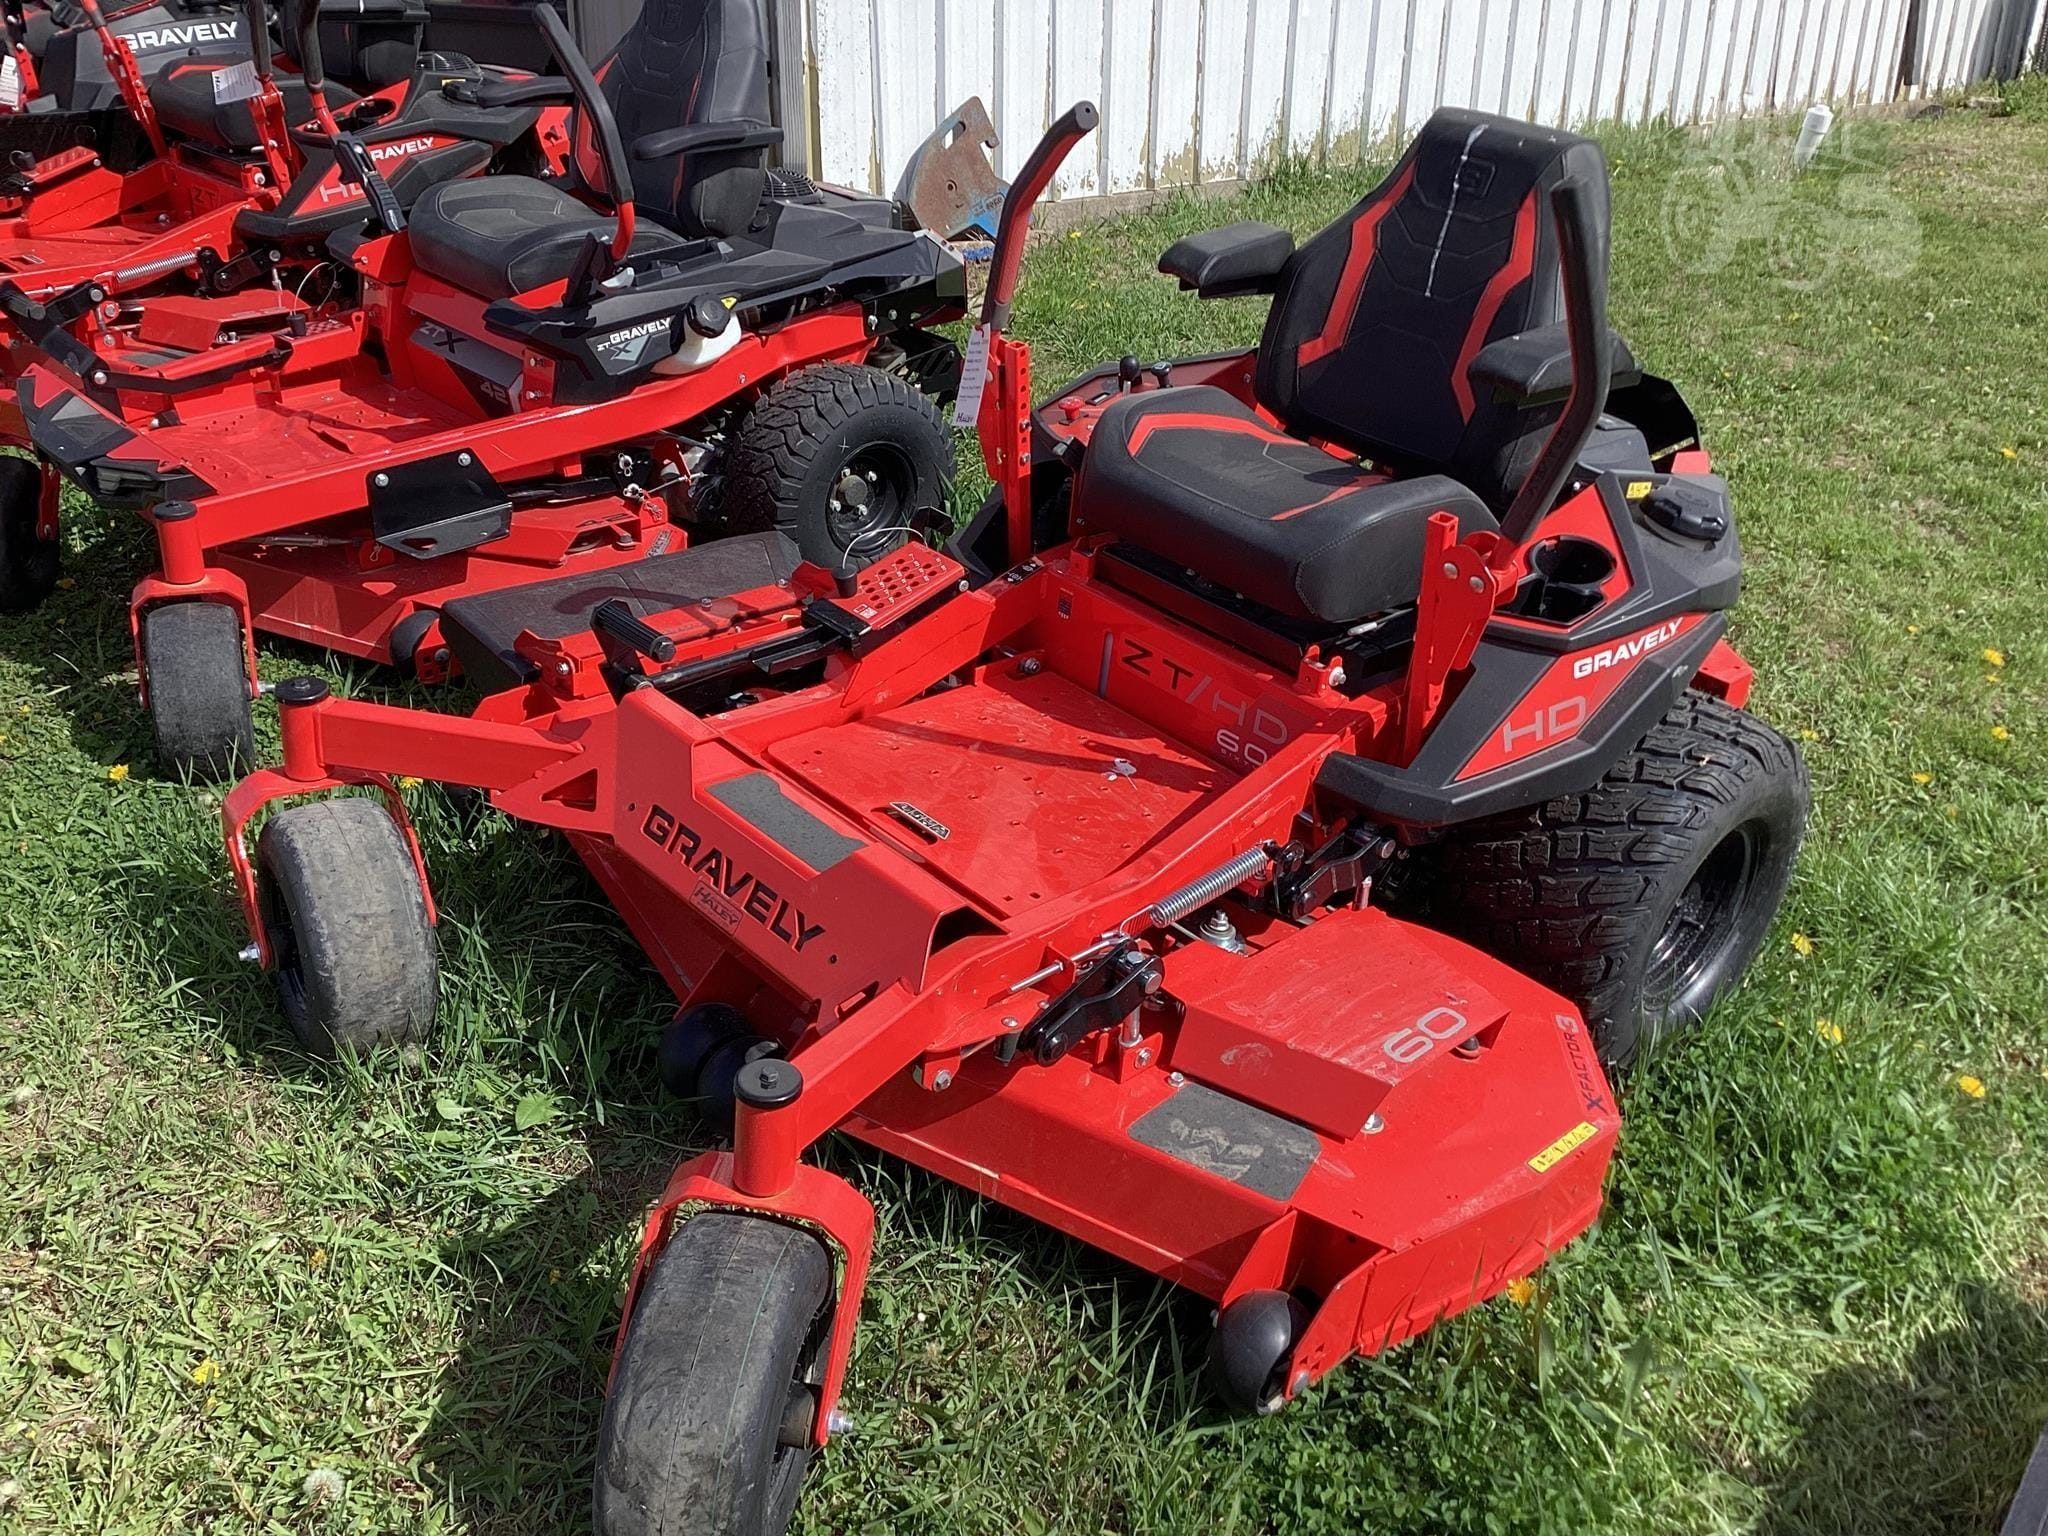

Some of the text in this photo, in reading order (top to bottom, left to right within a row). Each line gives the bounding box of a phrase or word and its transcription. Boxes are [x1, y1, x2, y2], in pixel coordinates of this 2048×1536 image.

[369, 137, 435, 162] RAVELY
[609, 317, 671, 345] GRAVELY
[1573, 617, 1683, 680] GRAVELY
[1216, 728, 1268, 767] 60
[1502, 695, 1587, 753] HD
[641, 803, 825, 953] GRAVELY
[1383, 1006, 1468, 1063] 60
